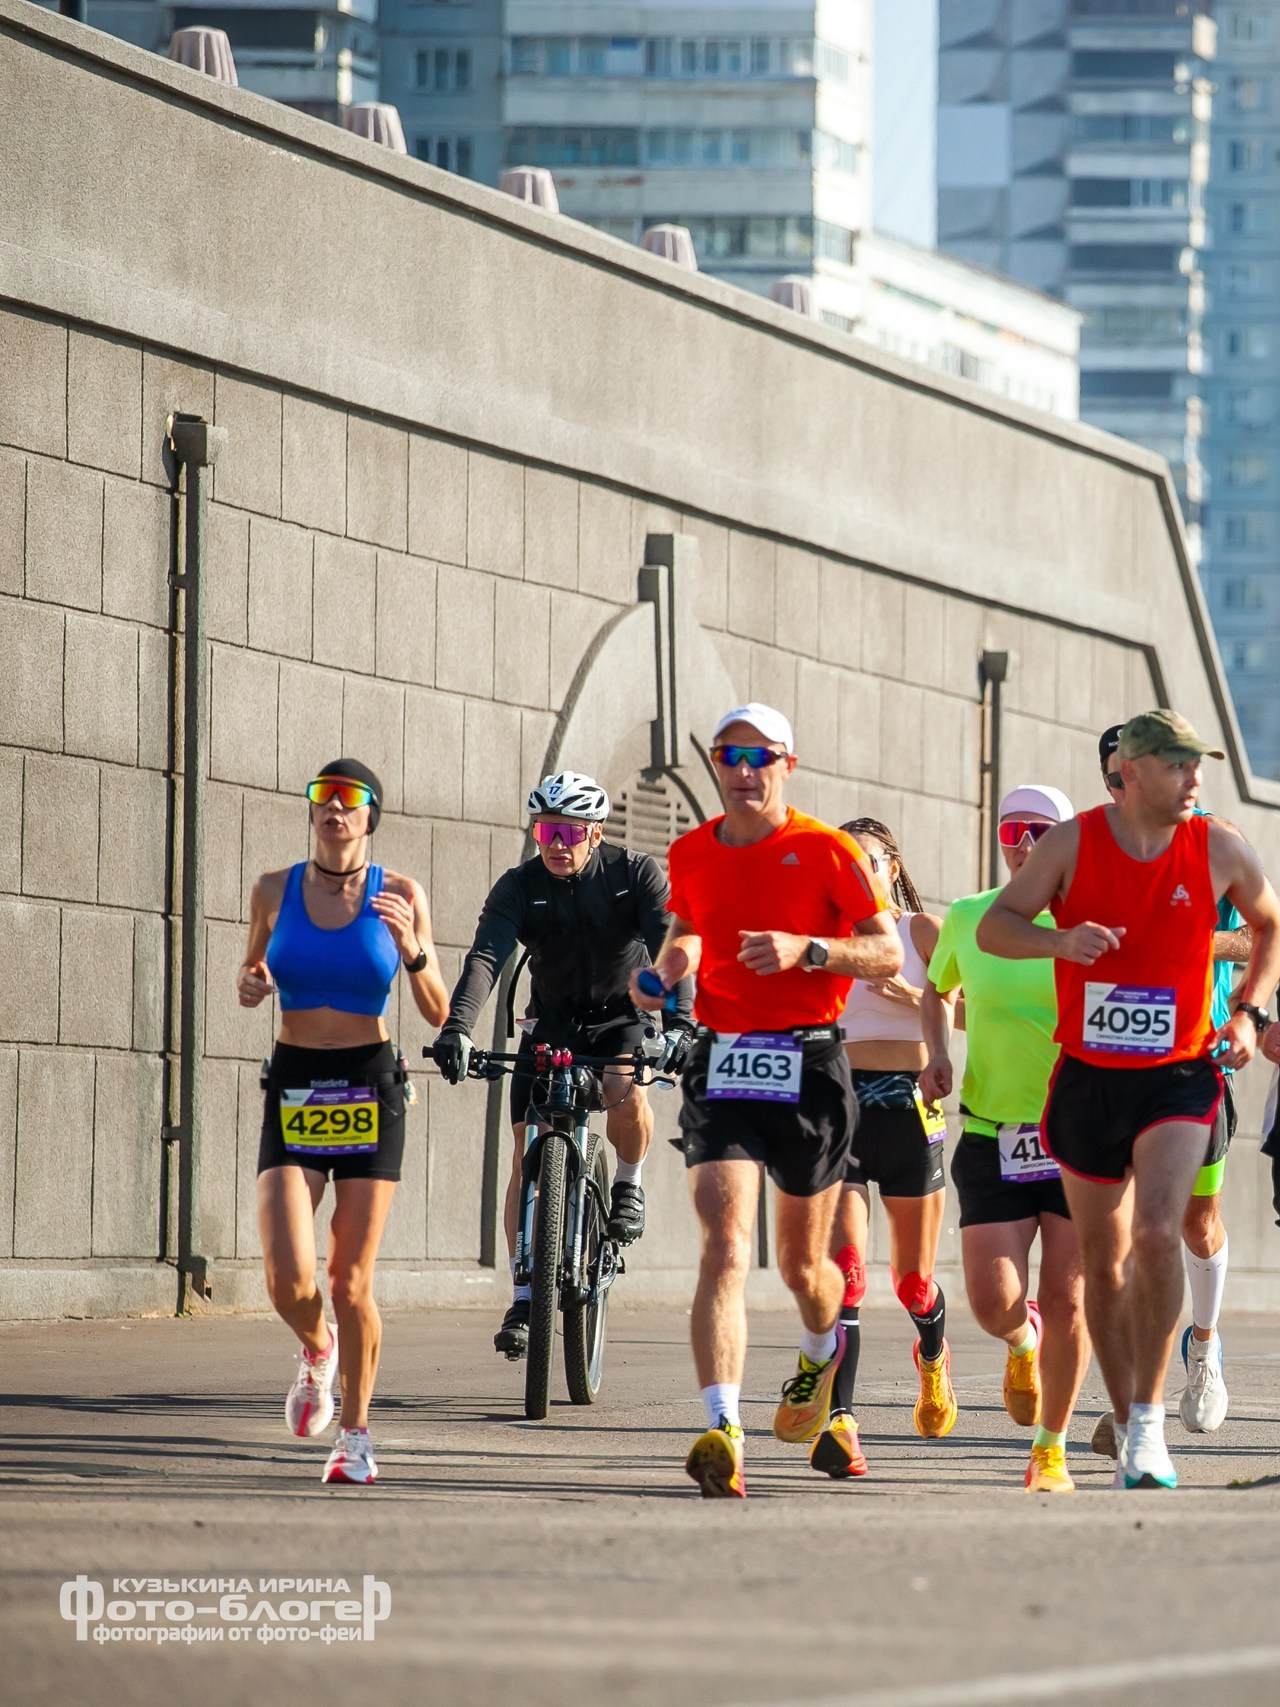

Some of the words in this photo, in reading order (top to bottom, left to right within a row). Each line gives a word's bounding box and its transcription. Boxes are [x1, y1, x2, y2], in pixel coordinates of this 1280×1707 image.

[1087, 1005, 1170, 1037] 4095
[716, 1053, 792, 1081] 4163
[286, 1107, 373, 1136] 4298
